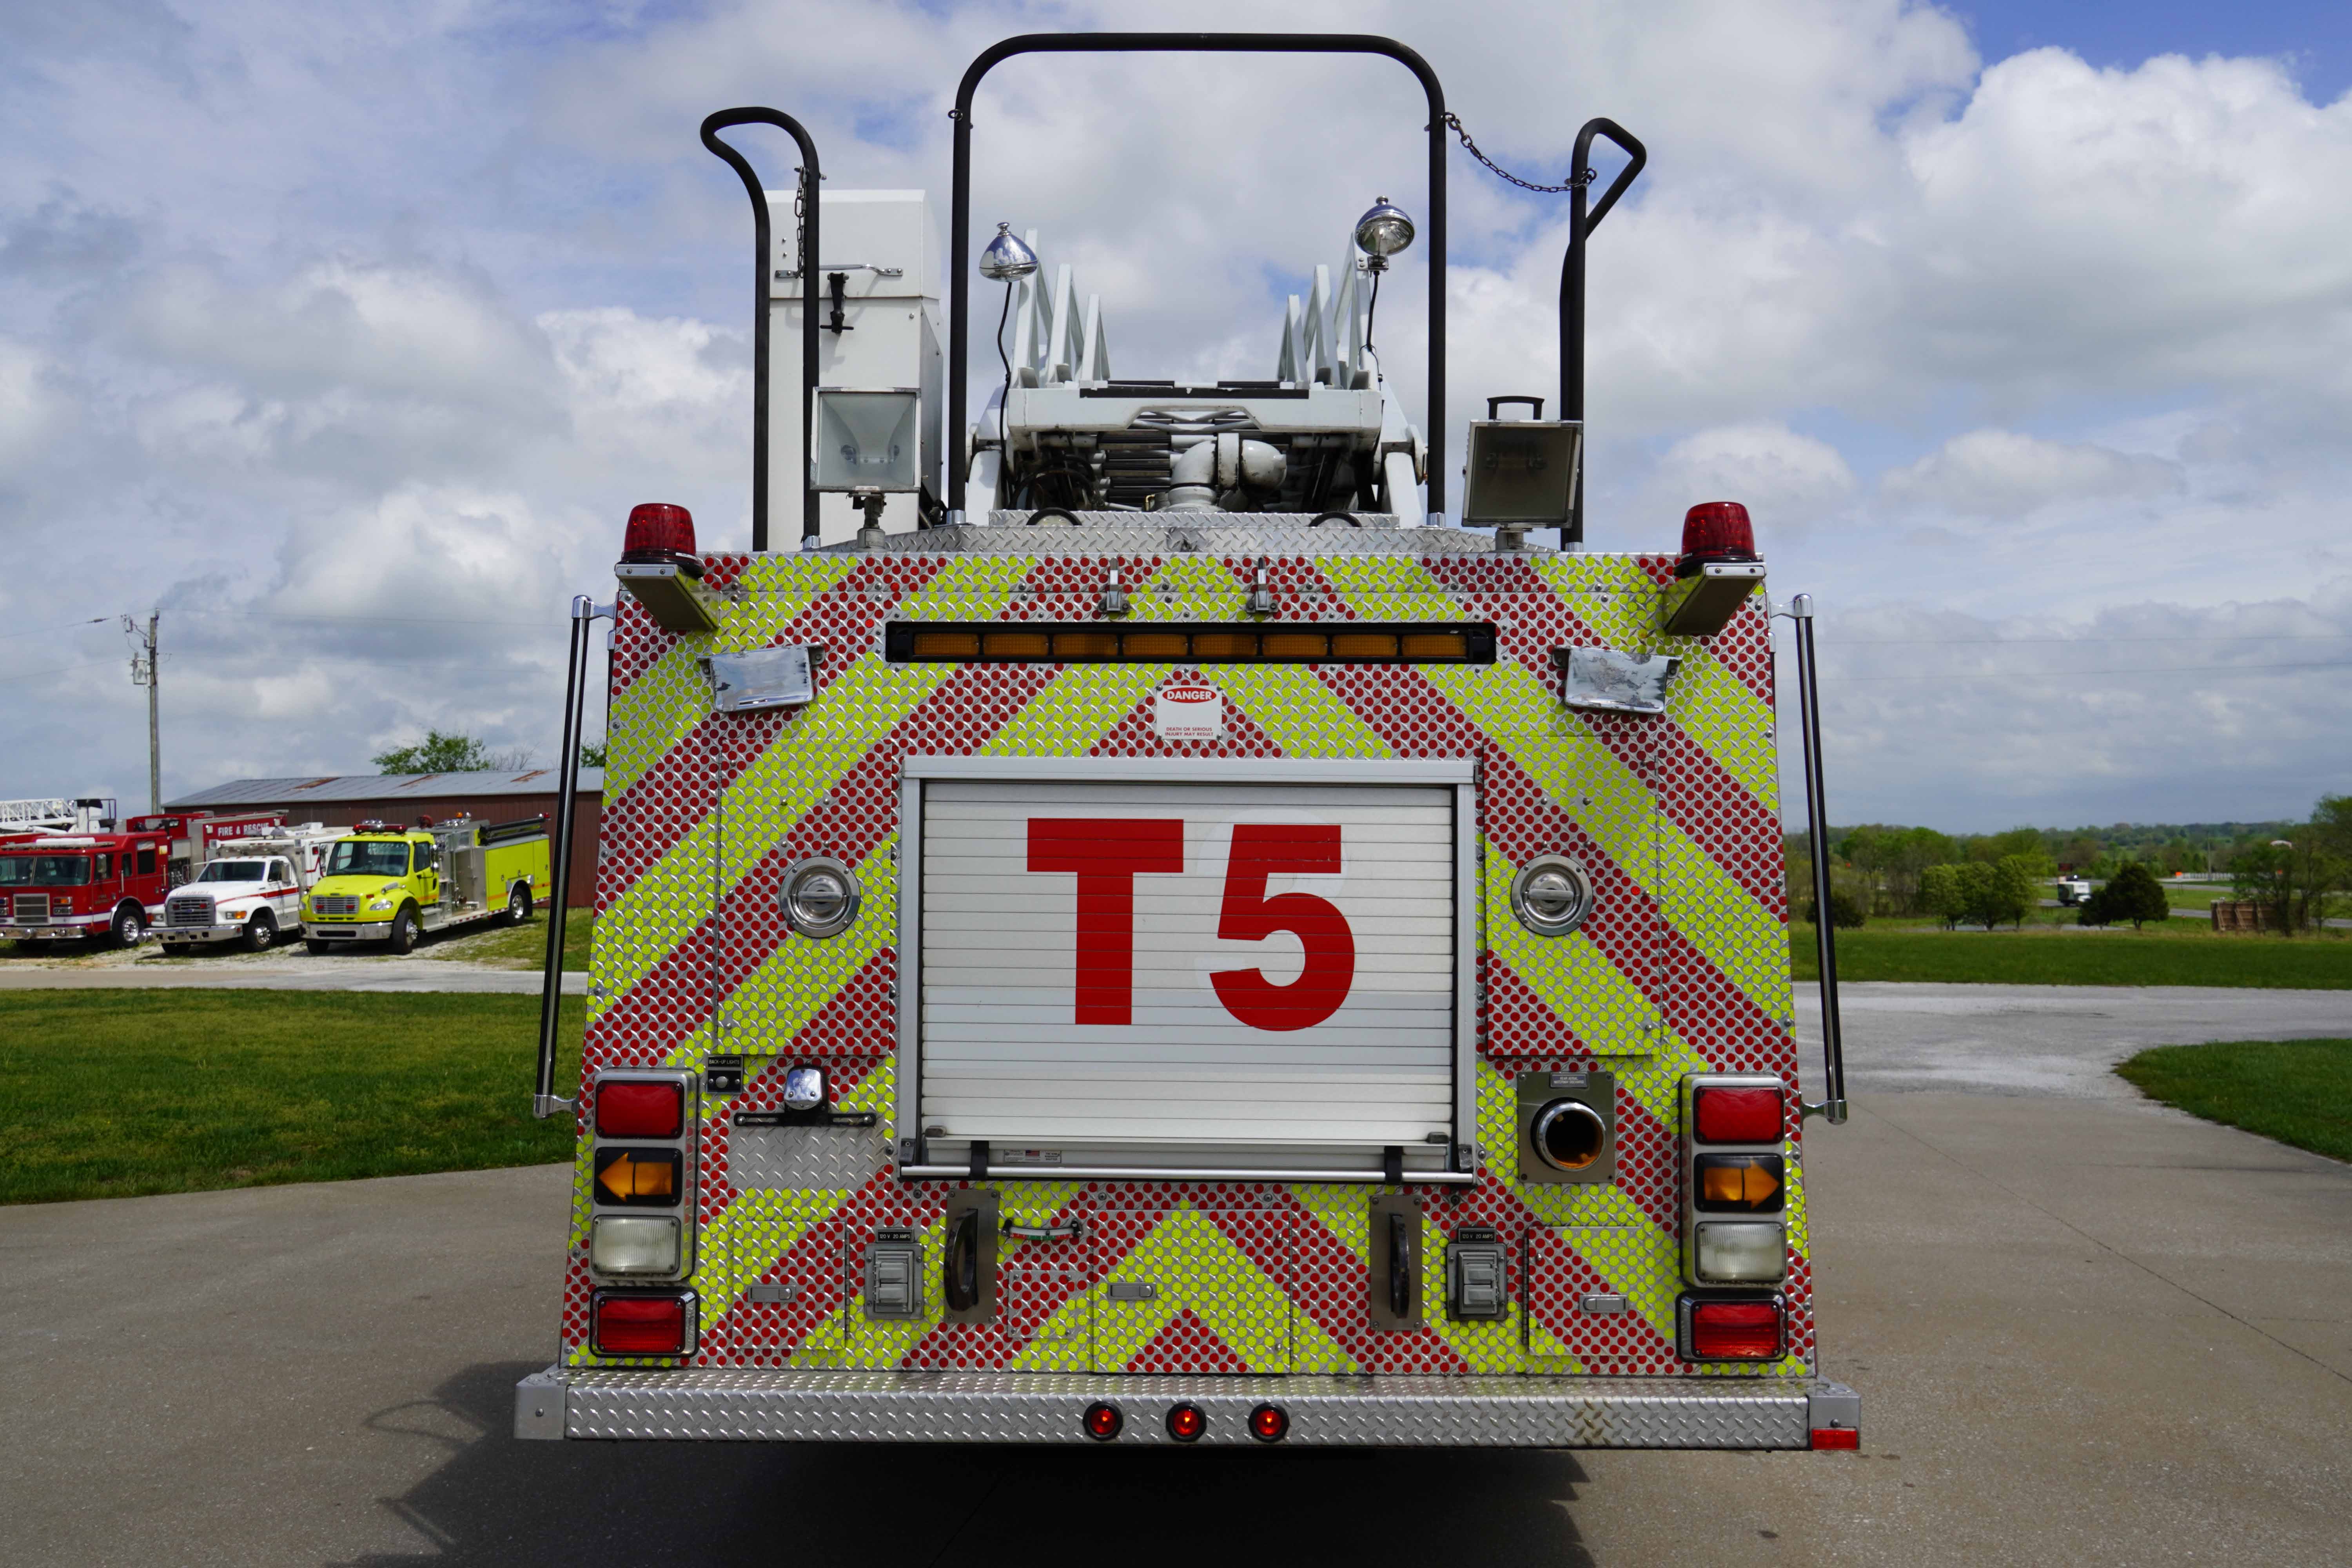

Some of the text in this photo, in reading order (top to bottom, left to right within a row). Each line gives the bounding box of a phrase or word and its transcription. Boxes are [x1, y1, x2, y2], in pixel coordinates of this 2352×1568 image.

[1167, 691, 1212, 700] DANGER
[218, 826, 233, 836] FIRE
[236, 826, 240, 834] &
[1027, 818, 1354, 1031] T5
